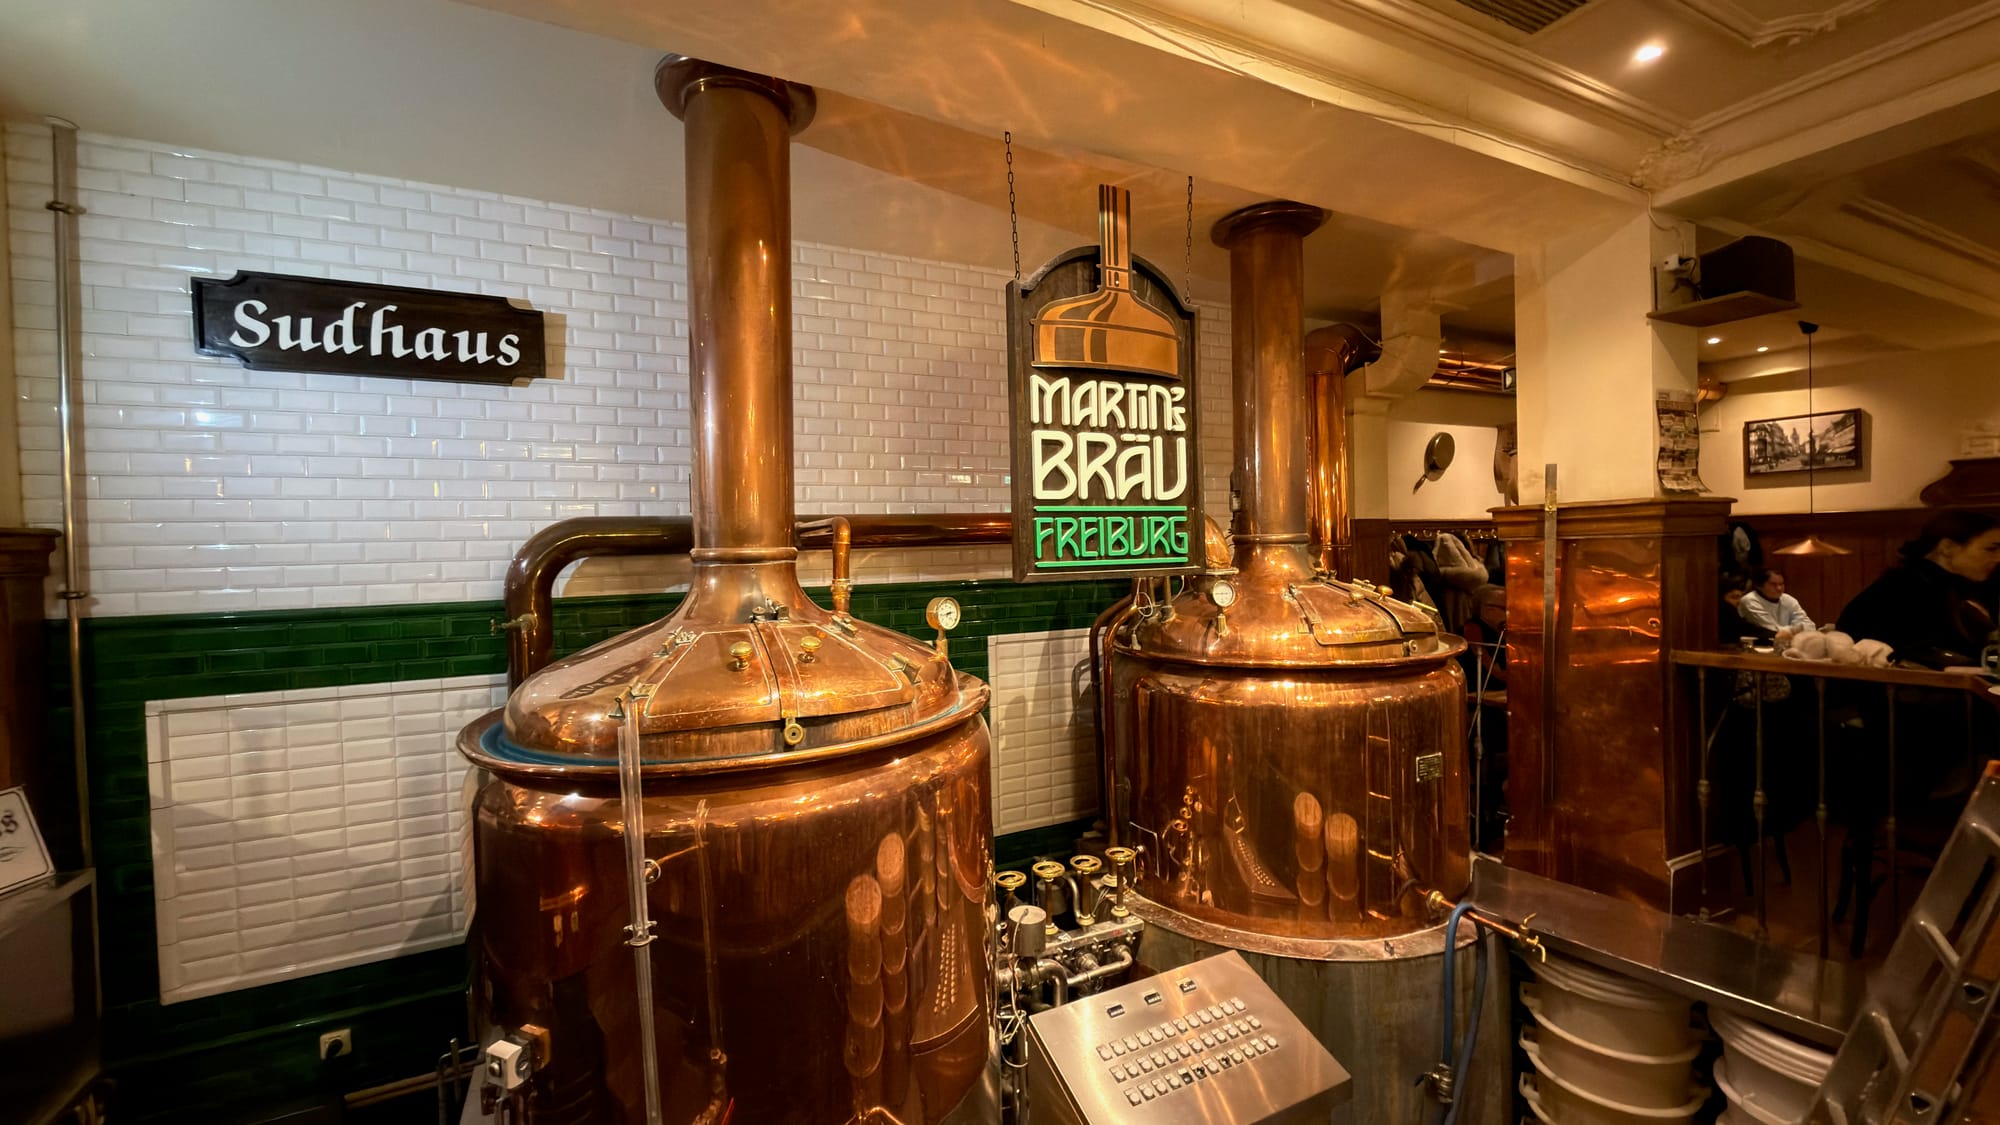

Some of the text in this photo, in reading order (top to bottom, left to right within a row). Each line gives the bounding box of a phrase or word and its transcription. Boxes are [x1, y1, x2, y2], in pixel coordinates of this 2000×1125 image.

[229, 299, 520, 366] Sudhaus
[1031, 429, 1188, 501] BRÄU
[1033, 516, 1189, 559] FREIBURG
